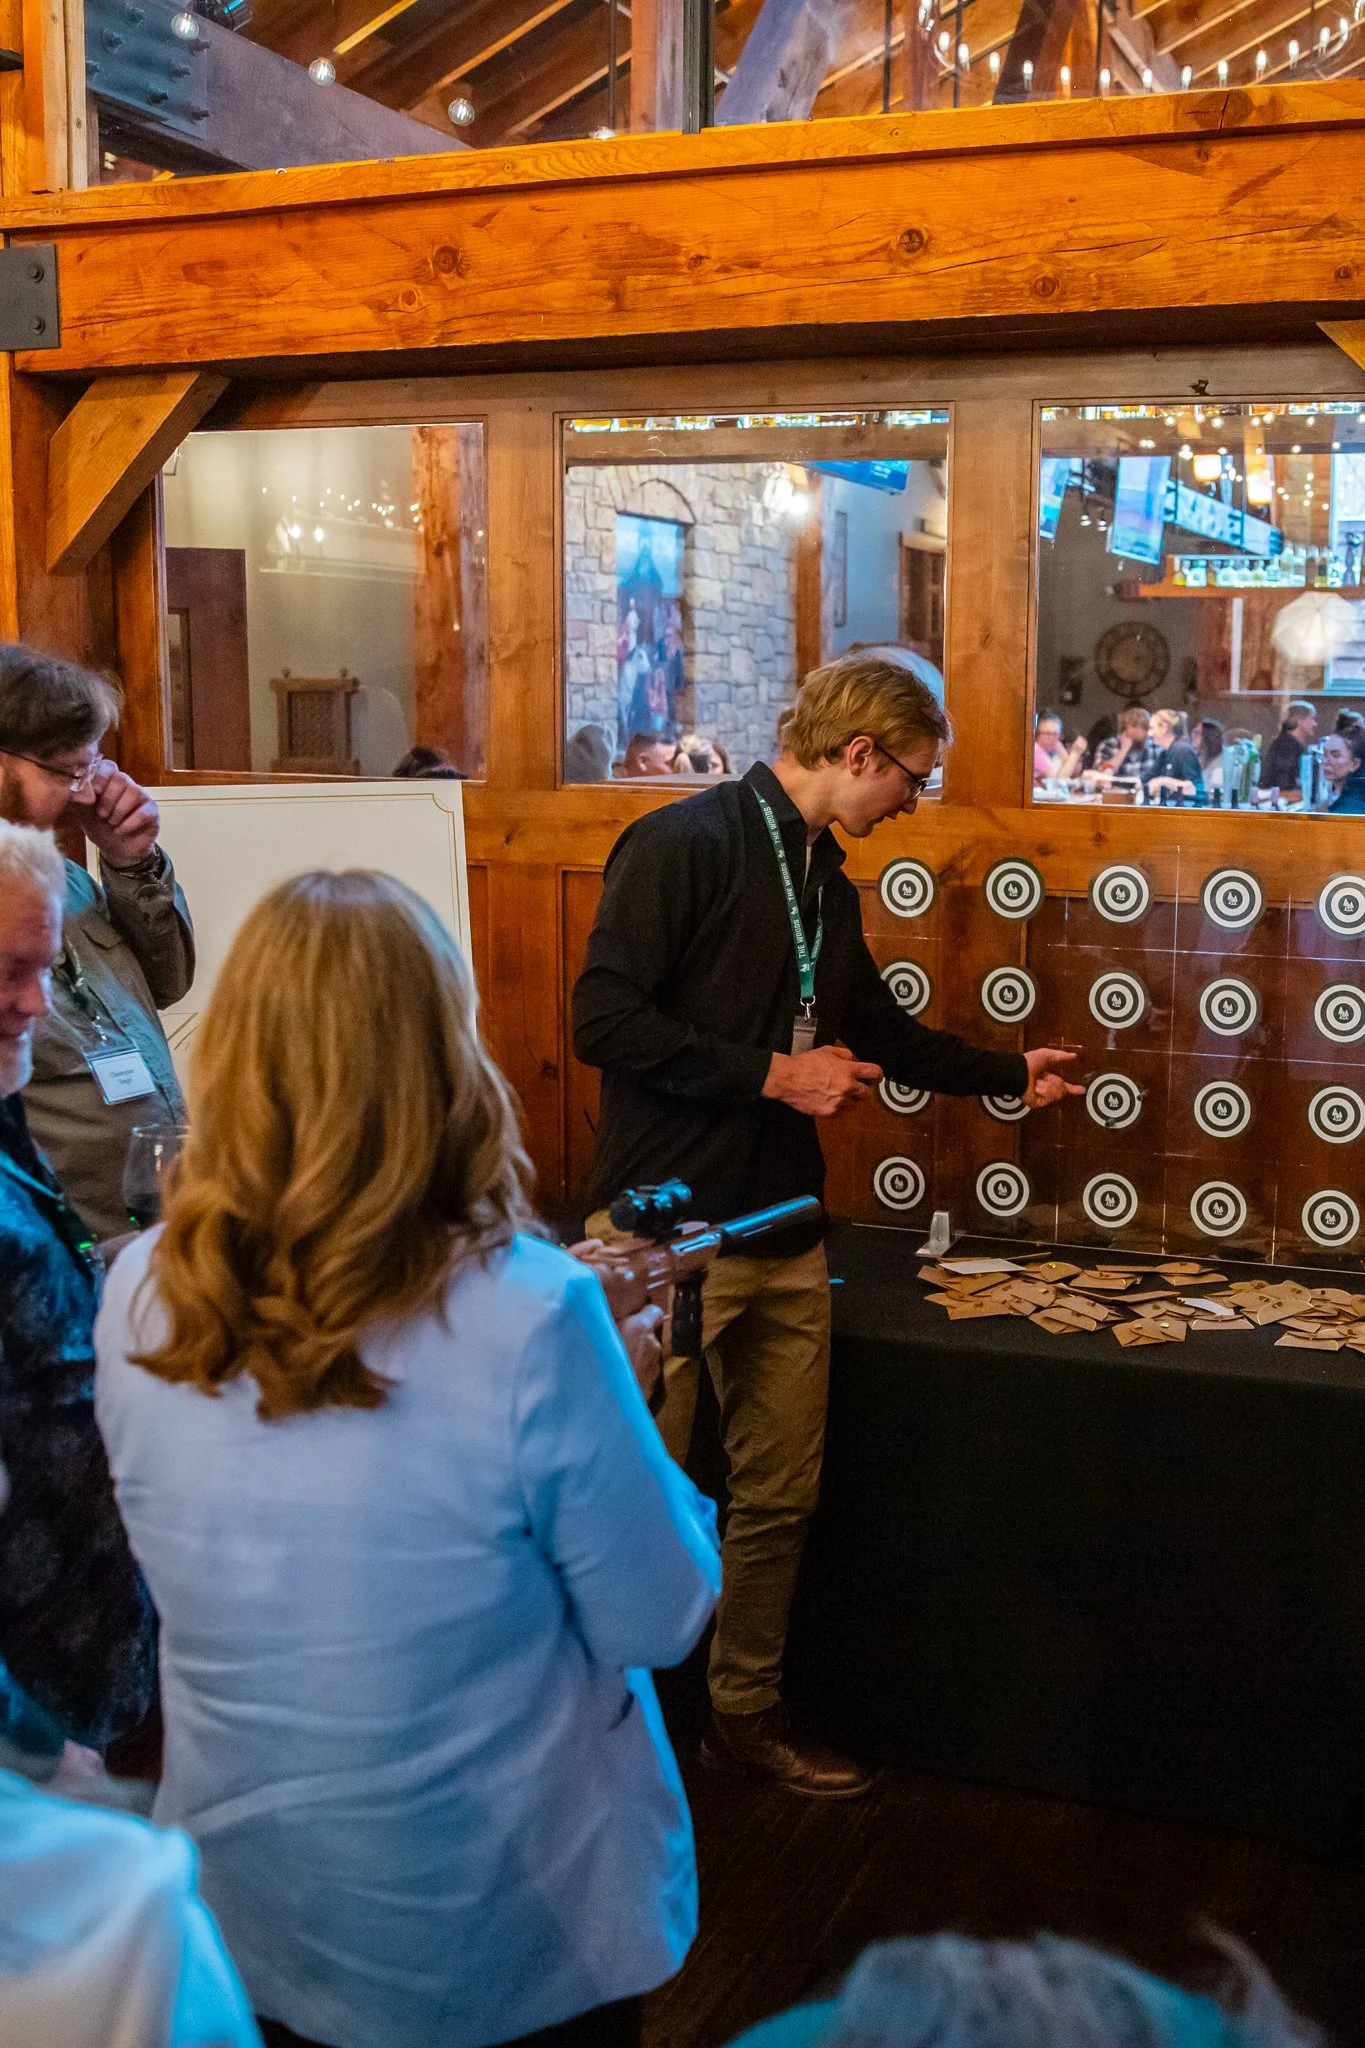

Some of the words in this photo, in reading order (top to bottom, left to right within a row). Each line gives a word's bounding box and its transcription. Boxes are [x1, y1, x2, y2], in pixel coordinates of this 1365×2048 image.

[763, 806, 777, 830] WOODS
[772, 831, 781, 844] THE
[780, 862, 791, 887] WOODS
[786, 888, 794, 902] THE
[793, 919, 804, 944] WOODS
[797, 944, 806, 959] THE
